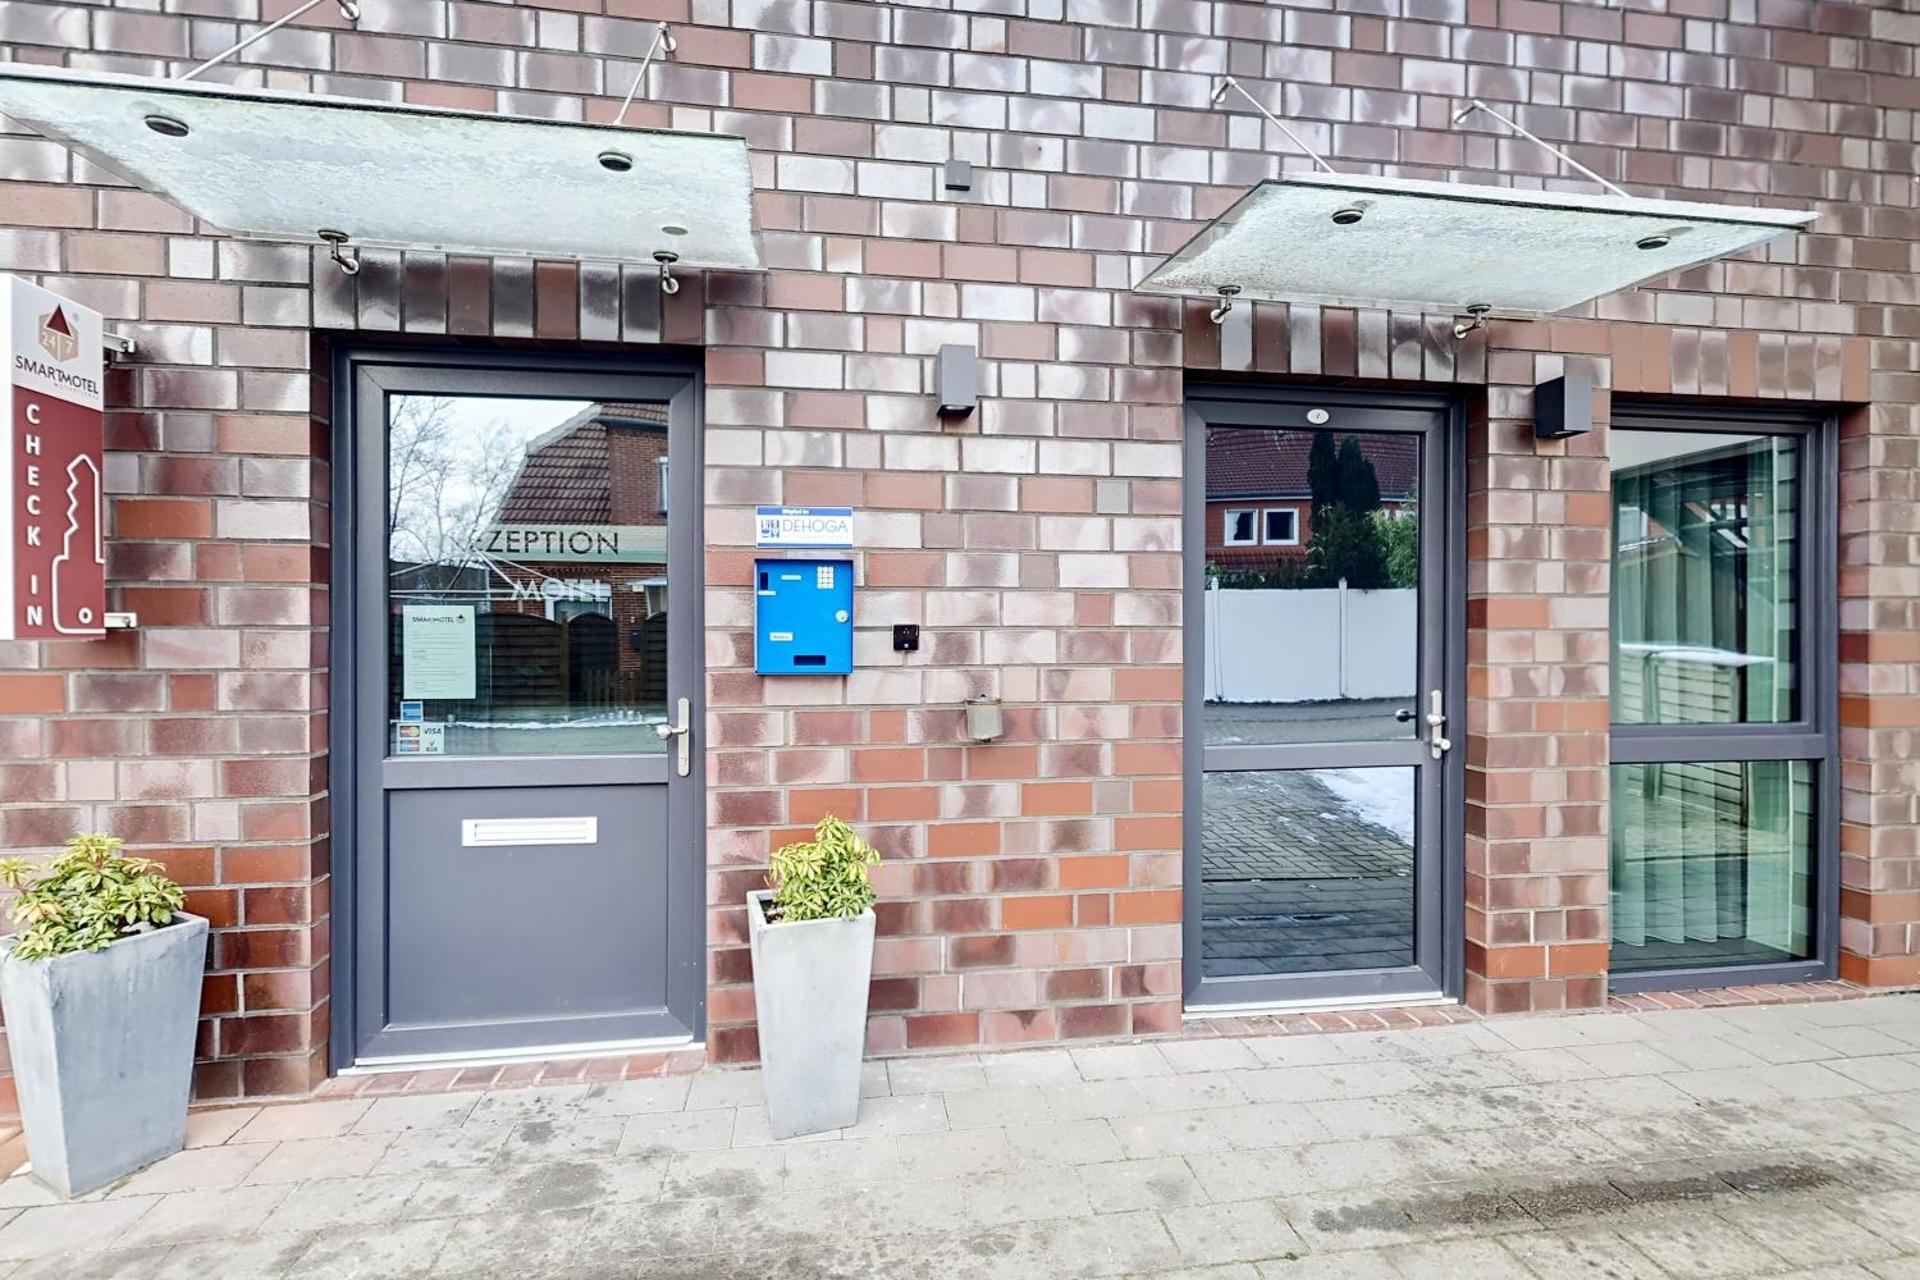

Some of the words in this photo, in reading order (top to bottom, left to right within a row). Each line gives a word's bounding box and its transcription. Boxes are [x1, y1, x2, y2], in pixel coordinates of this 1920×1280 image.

[15, 355, 99, 394] SMARTMOTEL
[26, 404, 41, 546] CHECK
[478, 530, 618, 555] ZEPTION
[782, 519, 848, 532] DEHOGA
[27, 574, 43, 626] IN
